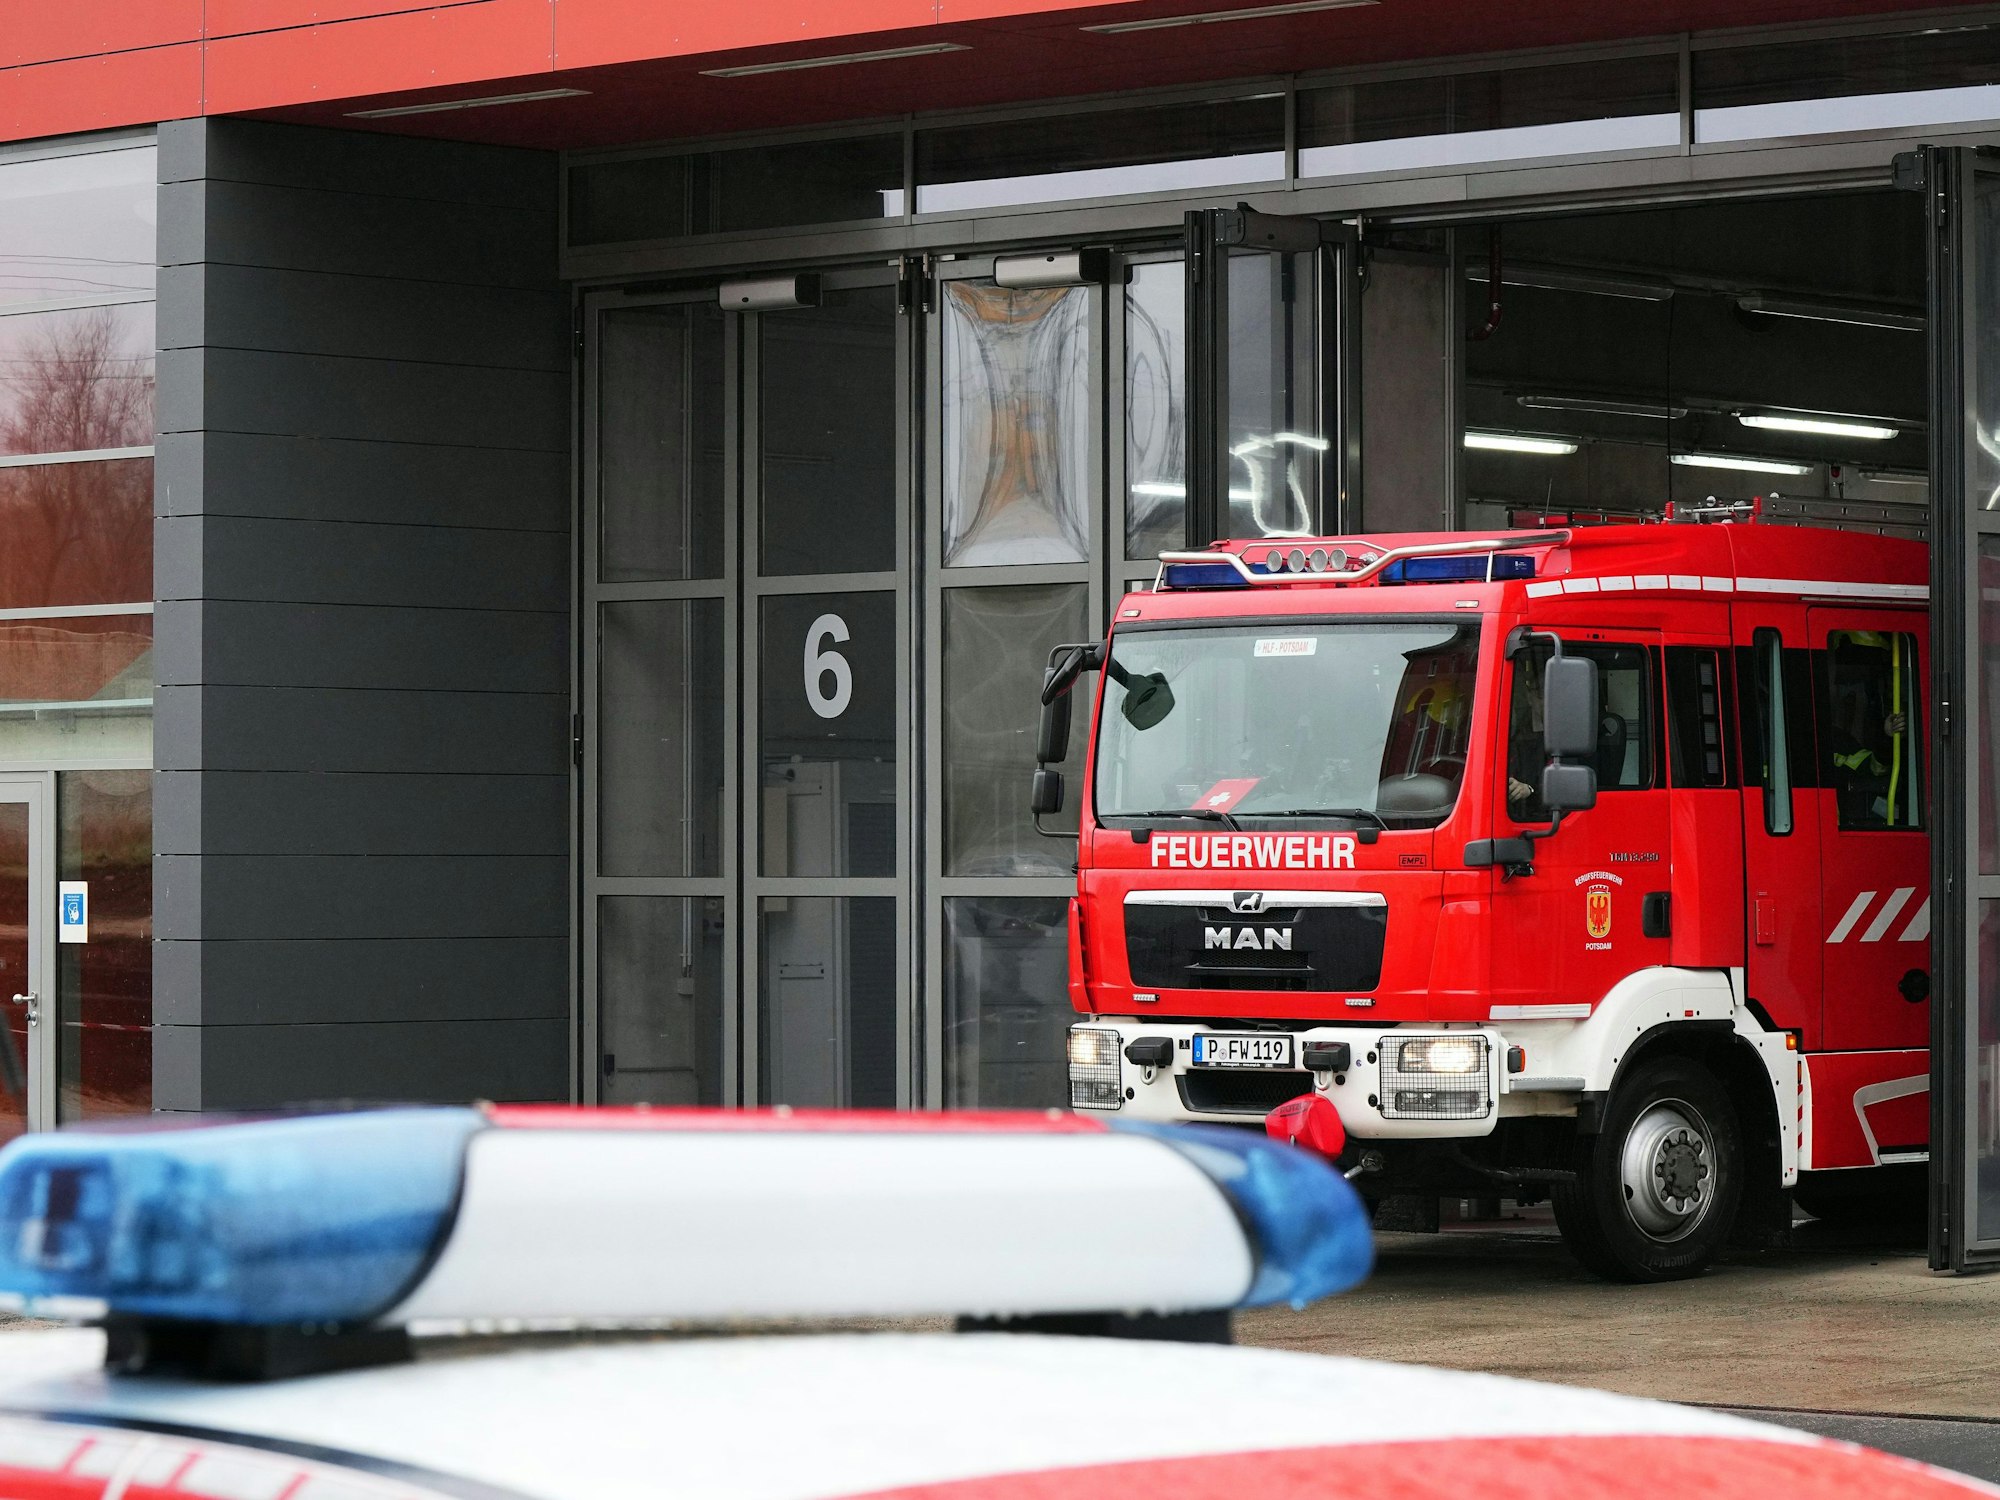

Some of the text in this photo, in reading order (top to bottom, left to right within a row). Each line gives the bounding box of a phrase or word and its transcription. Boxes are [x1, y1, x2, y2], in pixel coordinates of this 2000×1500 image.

[1279, 641, 1309, 653] POTSDAM
[803, 612, 853, 720] 6
[1151, 836, 1356, 869] FEUERWEHR
[1401, 856, 1425, 865] EMPL
[1574, 871, 1623, 886] BERUFSFEUERWEHR
[1204, 926, 1293, 950] MAN
[1585, 942, 1612, 951] POTSDAM
[1208, 1039, 1218, 1059] P
